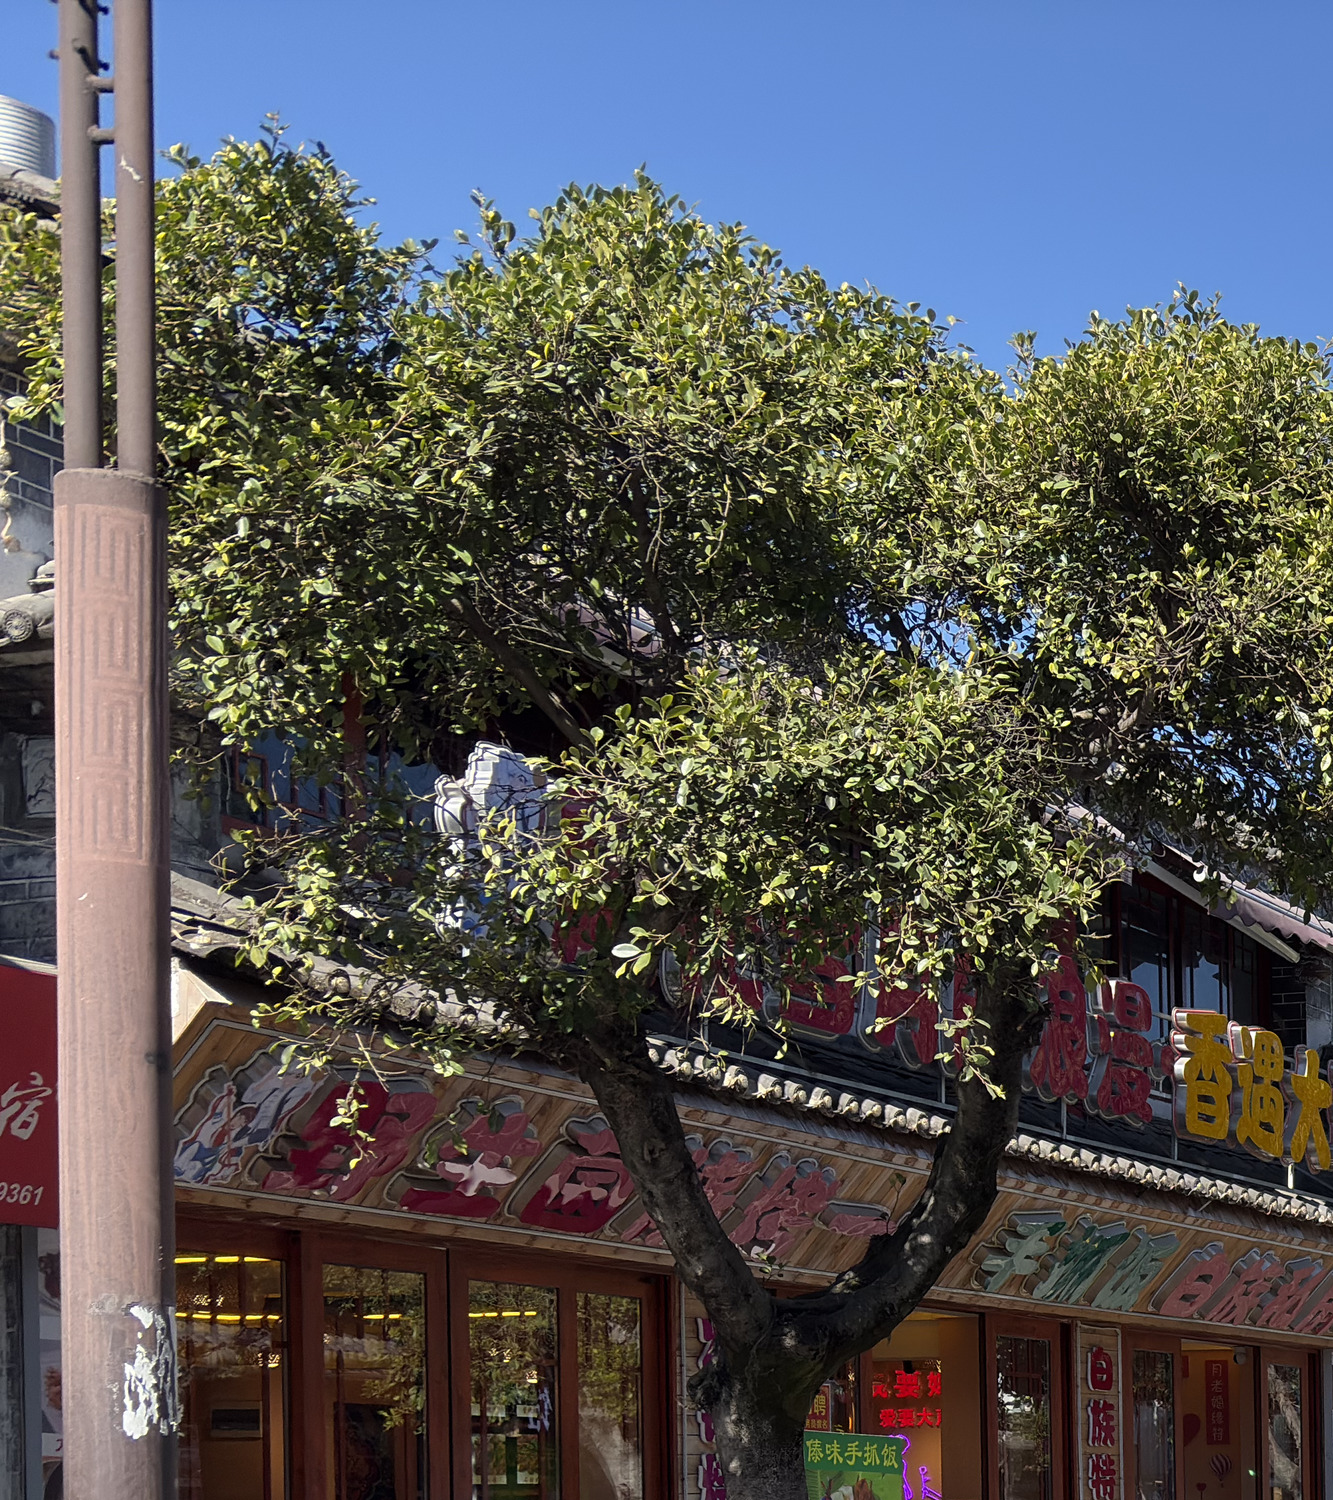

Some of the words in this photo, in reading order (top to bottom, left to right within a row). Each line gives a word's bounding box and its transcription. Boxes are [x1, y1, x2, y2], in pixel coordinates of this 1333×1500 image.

[806, 1439, 899, 1469] 傣味手抓饭
